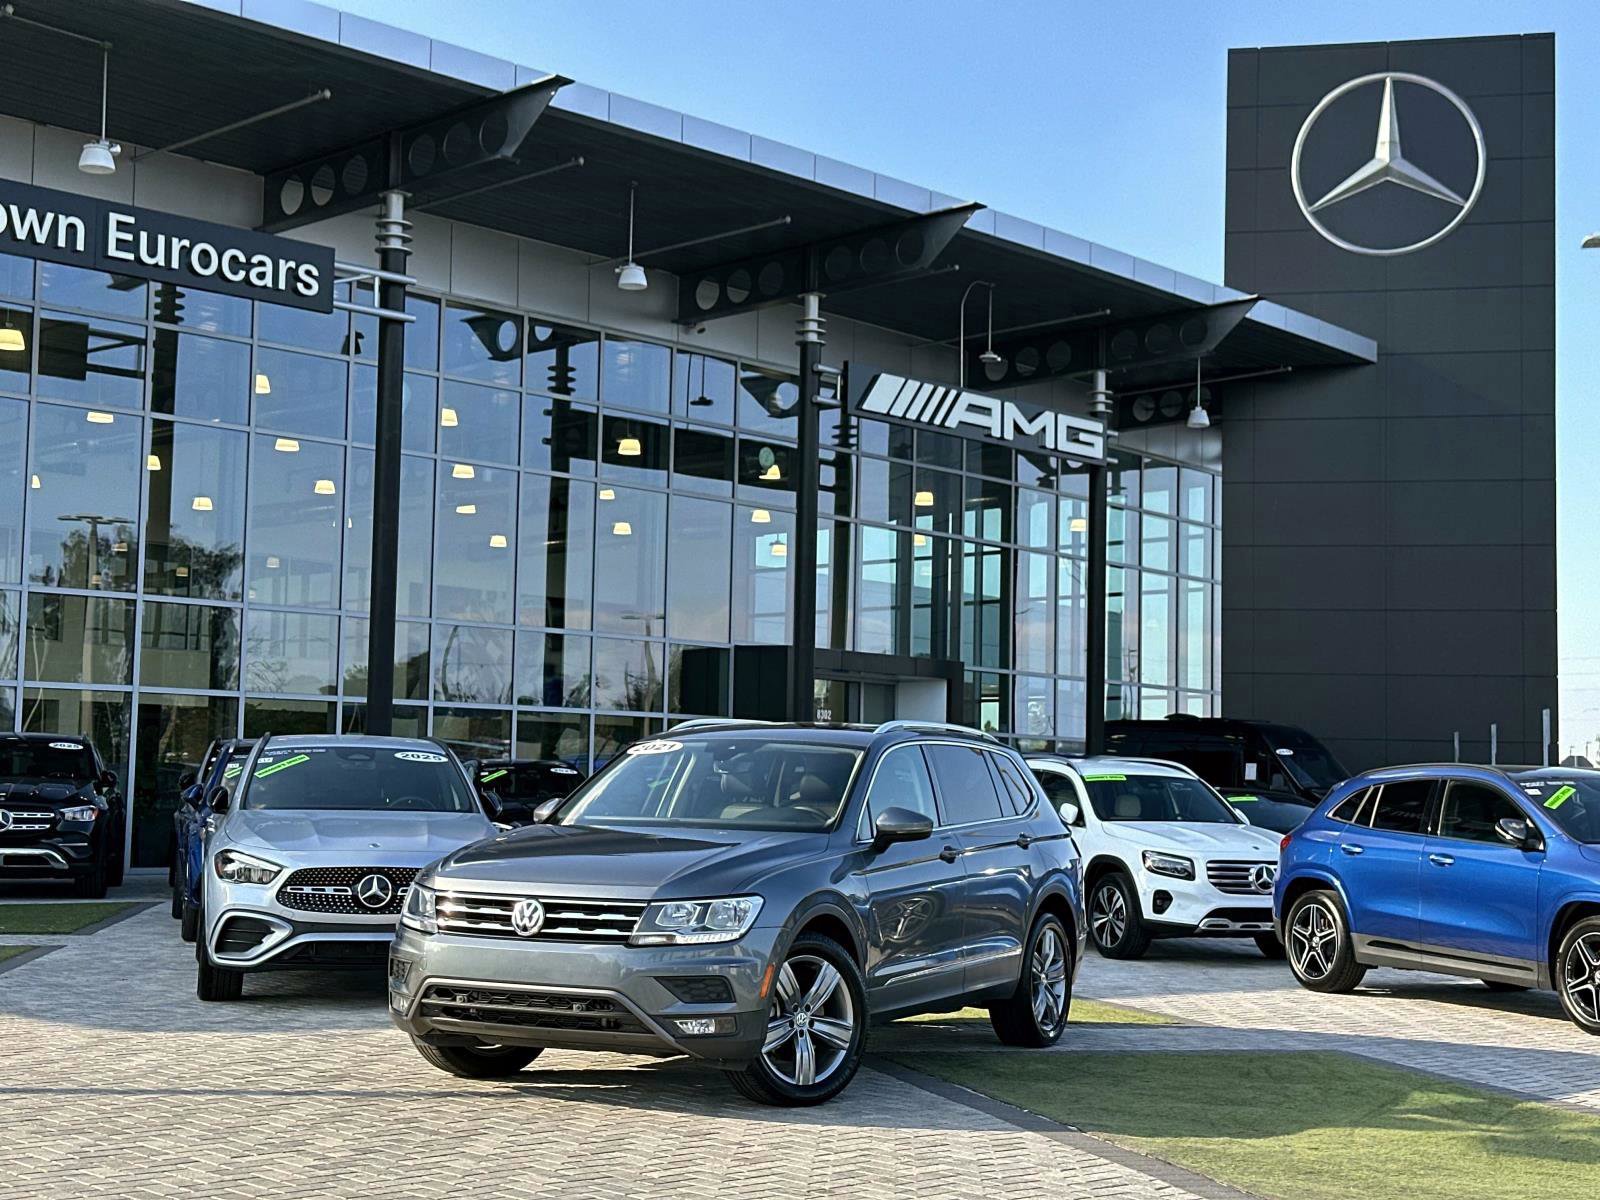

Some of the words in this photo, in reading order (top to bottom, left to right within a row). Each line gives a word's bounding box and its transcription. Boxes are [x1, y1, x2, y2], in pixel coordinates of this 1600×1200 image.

[0, 202, 85, 252] wn
[106, 210, 320, 297] Eurocars
[944, 390, 1104, 460] AMG
[400, 752, 442, 761] 2025
[633, 743, 678, 752] 2021
